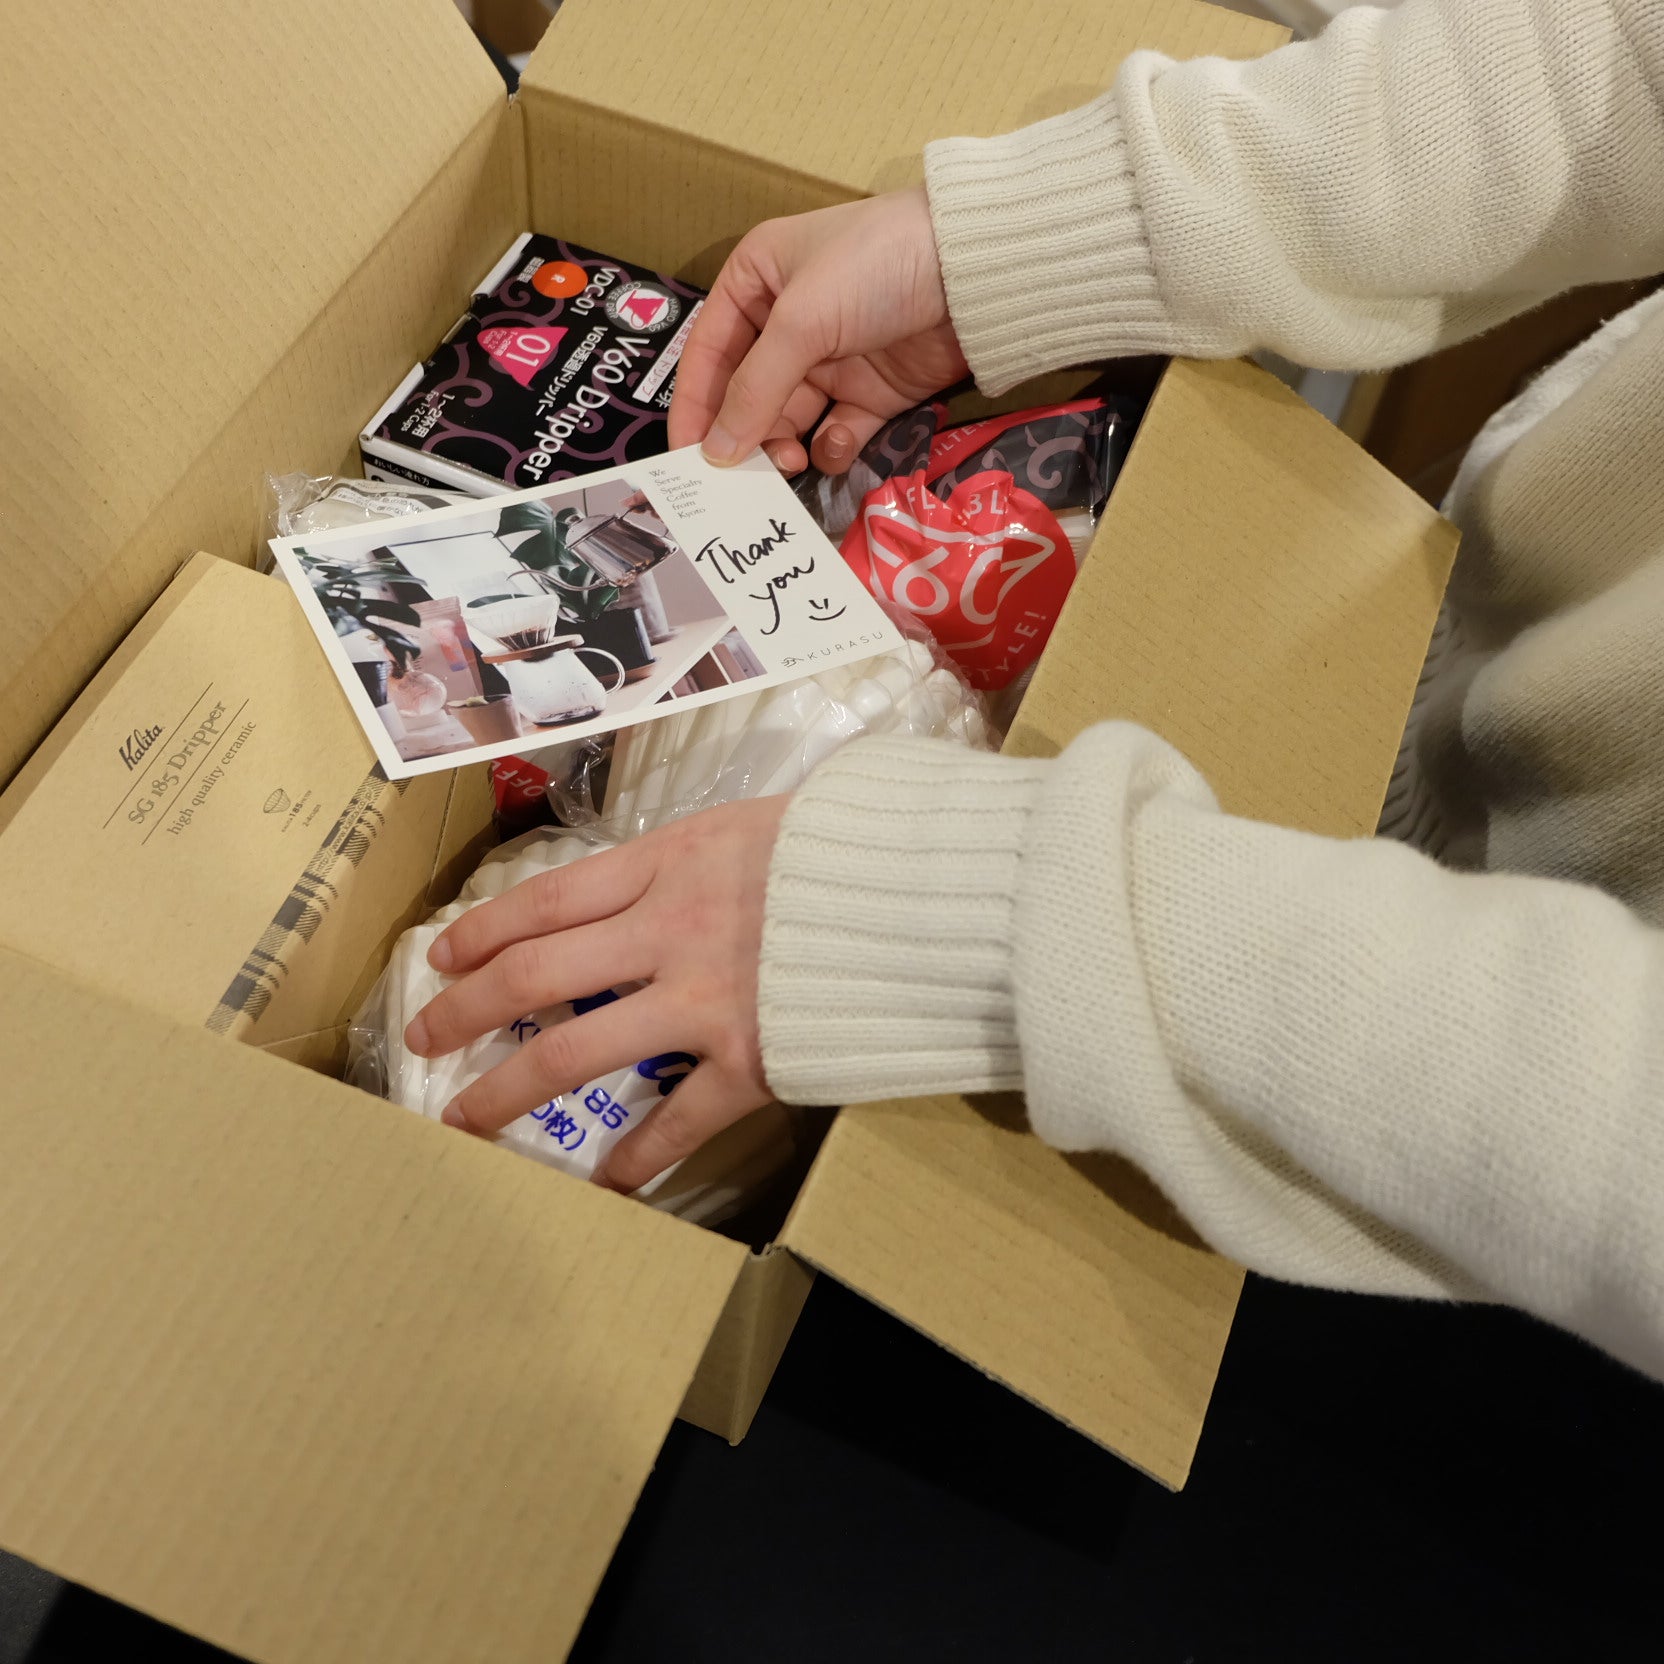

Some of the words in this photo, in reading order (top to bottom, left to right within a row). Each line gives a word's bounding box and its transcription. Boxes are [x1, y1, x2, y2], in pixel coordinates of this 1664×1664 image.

[552, 273, 566, 284] R
[570, 266, 621, 316] VDC-01
[609, 281, 641, 301] COFFEE
[667, 298, 679, 322] HARIO
[648, 321, 669, 332] V60
[506, 334, 551, 367] 01
[592, 336, 650, 384] V60
[535, 326, 609, 416] V60透過ドリッパー
[425, 390, 439, 402] For
[414, 402, 431, 416] 1-2
[401, 414, 420, 432] Cups
[522, 384, 610, 481] Dripper
[649, 469, 666, 478] We
[655, 475, 681, 487] Serve
[660, 480, 703, 495] Specialty
[666, 490, 699, 502] Coffee
[672, 500, 696, 511] from
[677, 508, 706, 519] Kyoto
[695, 518, 798, 584] Thank
[748, 556, 816, 636] you
[807, 631, 884, 660] KURASU
[118, 724, 164, 772] Kalita
[128, 798, 155, 824] SG
[151, 772, 180, 798] 185
[167, 701, 227, 770] Dripper
[166, 808, 195, 836] high
[191, 765, 226, 807] quality
[220, 721, 257, 765] ceramic
[289, 802, 304, 817] 185
